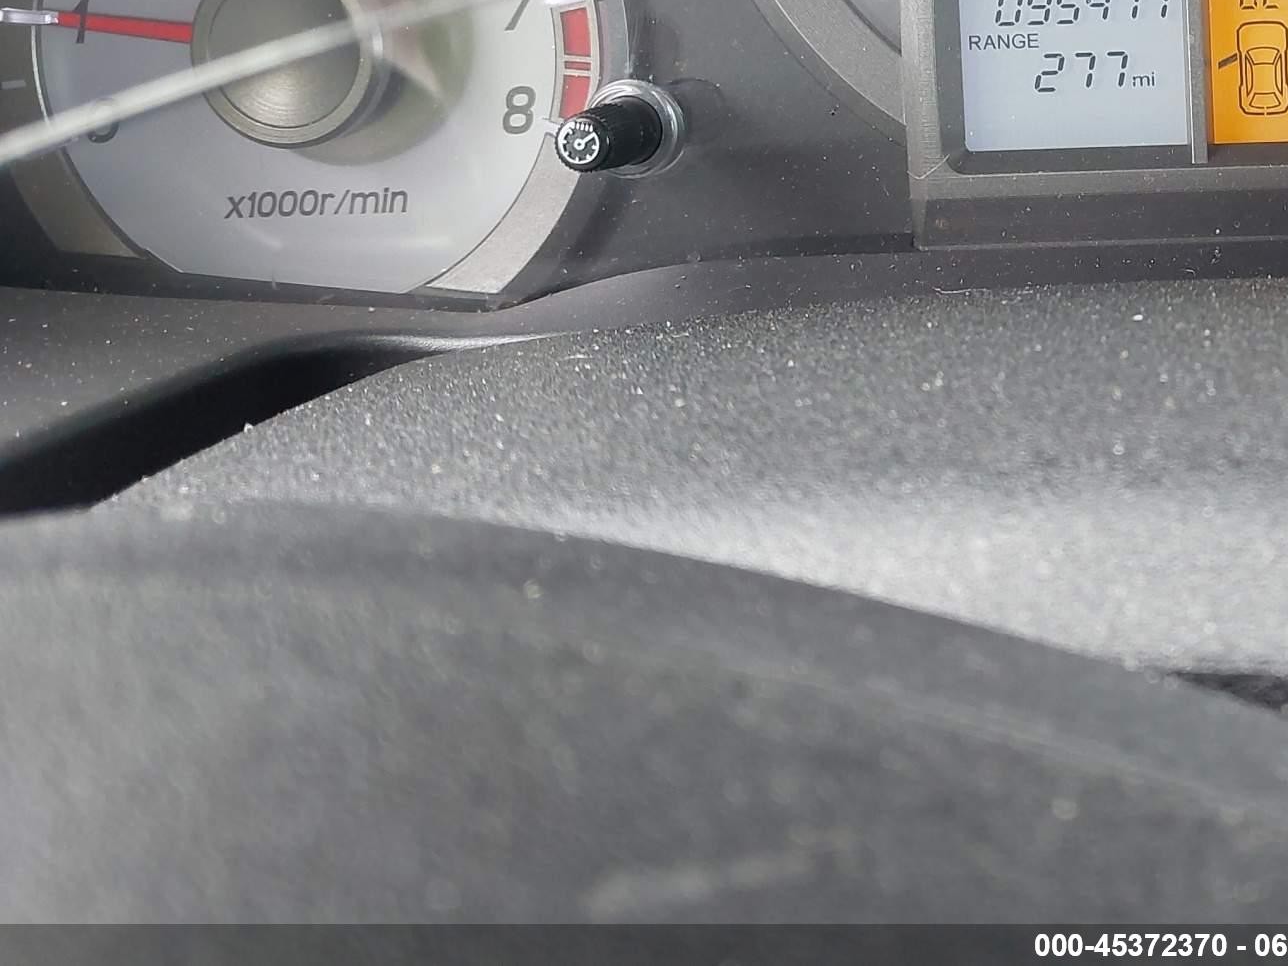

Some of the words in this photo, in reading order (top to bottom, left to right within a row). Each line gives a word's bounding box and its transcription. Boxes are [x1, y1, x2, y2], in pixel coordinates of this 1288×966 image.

[968, 33, 1039, 51] RANGE
[1034, 51, 1129, 93] 277
[1132, 71, 1156, 88] mi
[502, 86, 535, 134] 8
[225, 188, 408, 220] x1000r/min
